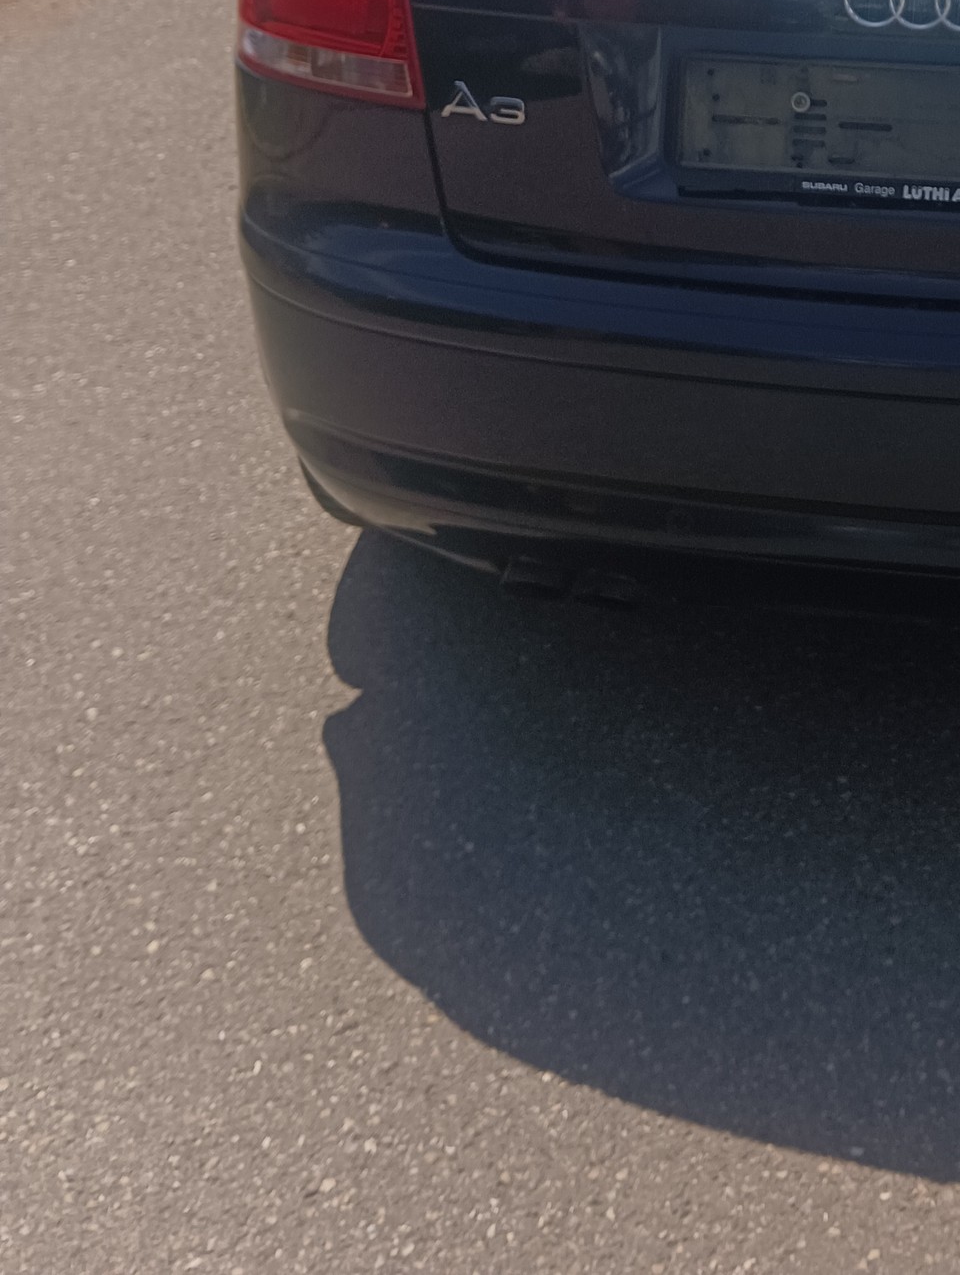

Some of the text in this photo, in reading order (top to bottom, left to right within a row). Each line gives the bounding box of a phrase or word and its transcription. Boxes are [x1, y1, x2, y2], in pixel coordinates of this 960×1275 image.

[441, 80, 525, 125] A3
[801, 181, 848, 192] SUBARU
[854, 182, 895, 197] Garage
